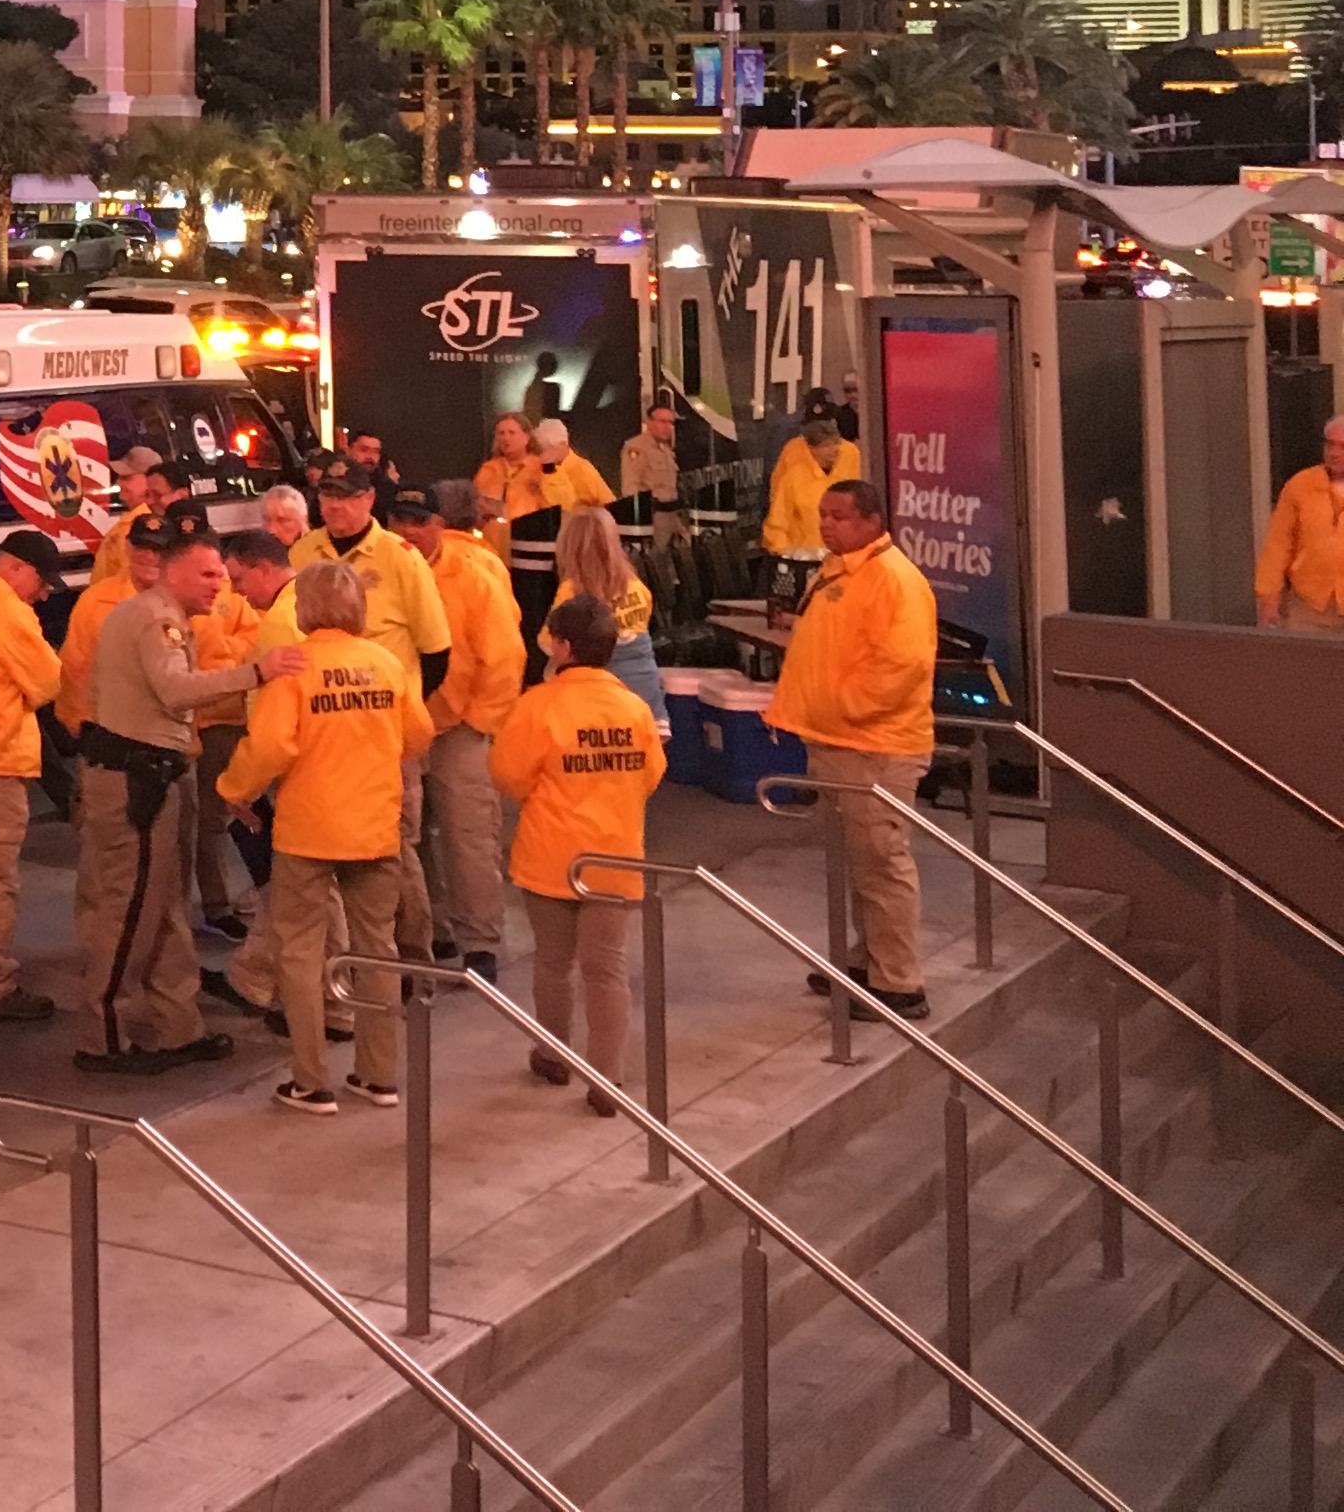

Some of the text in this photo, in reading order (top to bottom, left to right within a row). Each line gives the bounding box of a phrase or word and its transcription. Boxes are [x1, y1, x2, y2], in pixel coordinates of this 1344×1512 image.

[379, 214, 583, 234] freeinterional.org
[717, 225, 742, 321] THE
[440, 289, 524, 337] STL
[745, 257, 824, 420] 141
[42, 349, 129, 379] MEDICWEST
[429, 351, 464, 362] SPEED
[468, 352, 489, 363] THE
[896, 432, 947, 474] Tell
[897, 479, 981, 526] Better
[898, 526, 992, 576] Stories
[310, 690, 394, 714] VOLUNTEER
[577, 727, 633, 749] POLICE
[562, 750, 646, 775] VOLUNTEER
